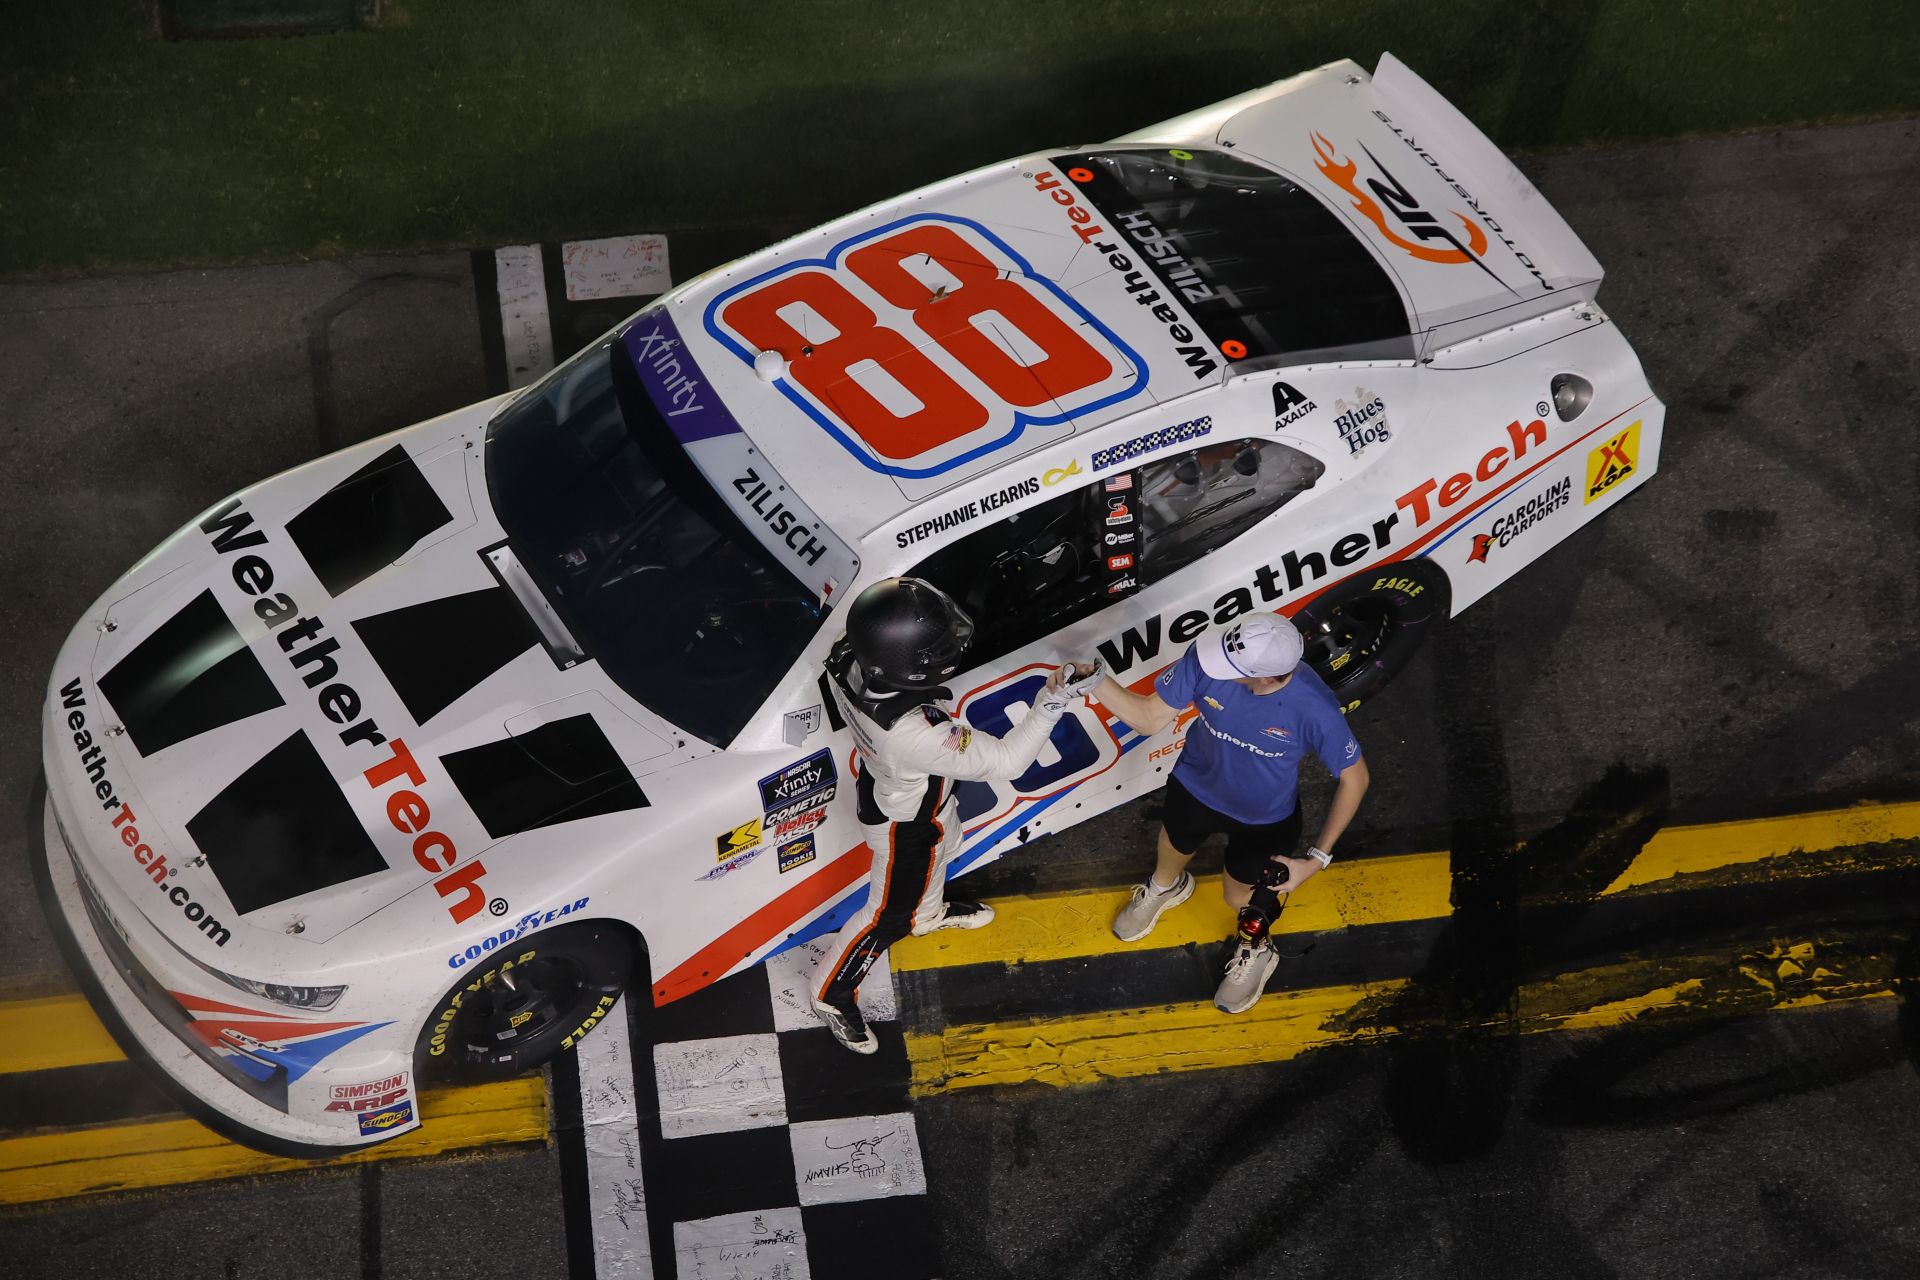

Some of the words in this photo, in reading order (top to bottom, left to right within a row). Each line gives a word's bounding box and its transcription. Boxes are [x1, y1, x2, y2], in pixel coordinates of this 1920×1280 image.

[1371, 110, 1554, 290] MOTORSPORTS
[1115, 211, 1214, 304] ZILISCH
[722, 225, 1112, 459] 88
[639, 326, 704, 417] xfinity
[1275, 401, 1317, 431] AXALTA
[1334, 397, 1384, 438] Blues
[1347, 419, 1390, 455] Hog
[1589, 464, 1633, 498] KOA
[732, 467, 827, 566] ZILISCH
[895, 504, 979, 549] STEPHANIE
[981, 477, 1040, 515] KEARNS
[1491, 476, 1571, 538] CAROLINA
[1498, 492, 1570, 548] CARPORTS
[1111, 557, 1130, 568] SEM
[1371, 576, 1426, 598] EAGLE
[774, 767, 822, 798] xfinity
[787, 760, 811, 777] NASCAR
[790, 785, 811, 797] SERIES
[765, 787, 835, 827] COMETIC
[775, 805, 827, 836] Holley
[773, 820, 819, 846] MSD
[718, 839, 761, 863] KENNAMETAL
[781, 851, 814, 868] ROOKIE
[561, 996, 615, 1050] EAGLE
[324, 1088, 407, 1112] ARP
[334, 1074, 403, 1098] SIMPSON
[361, 1108, 411, 1128] SUNOCO
[804, 1161, 850, 1183] SHAWN
